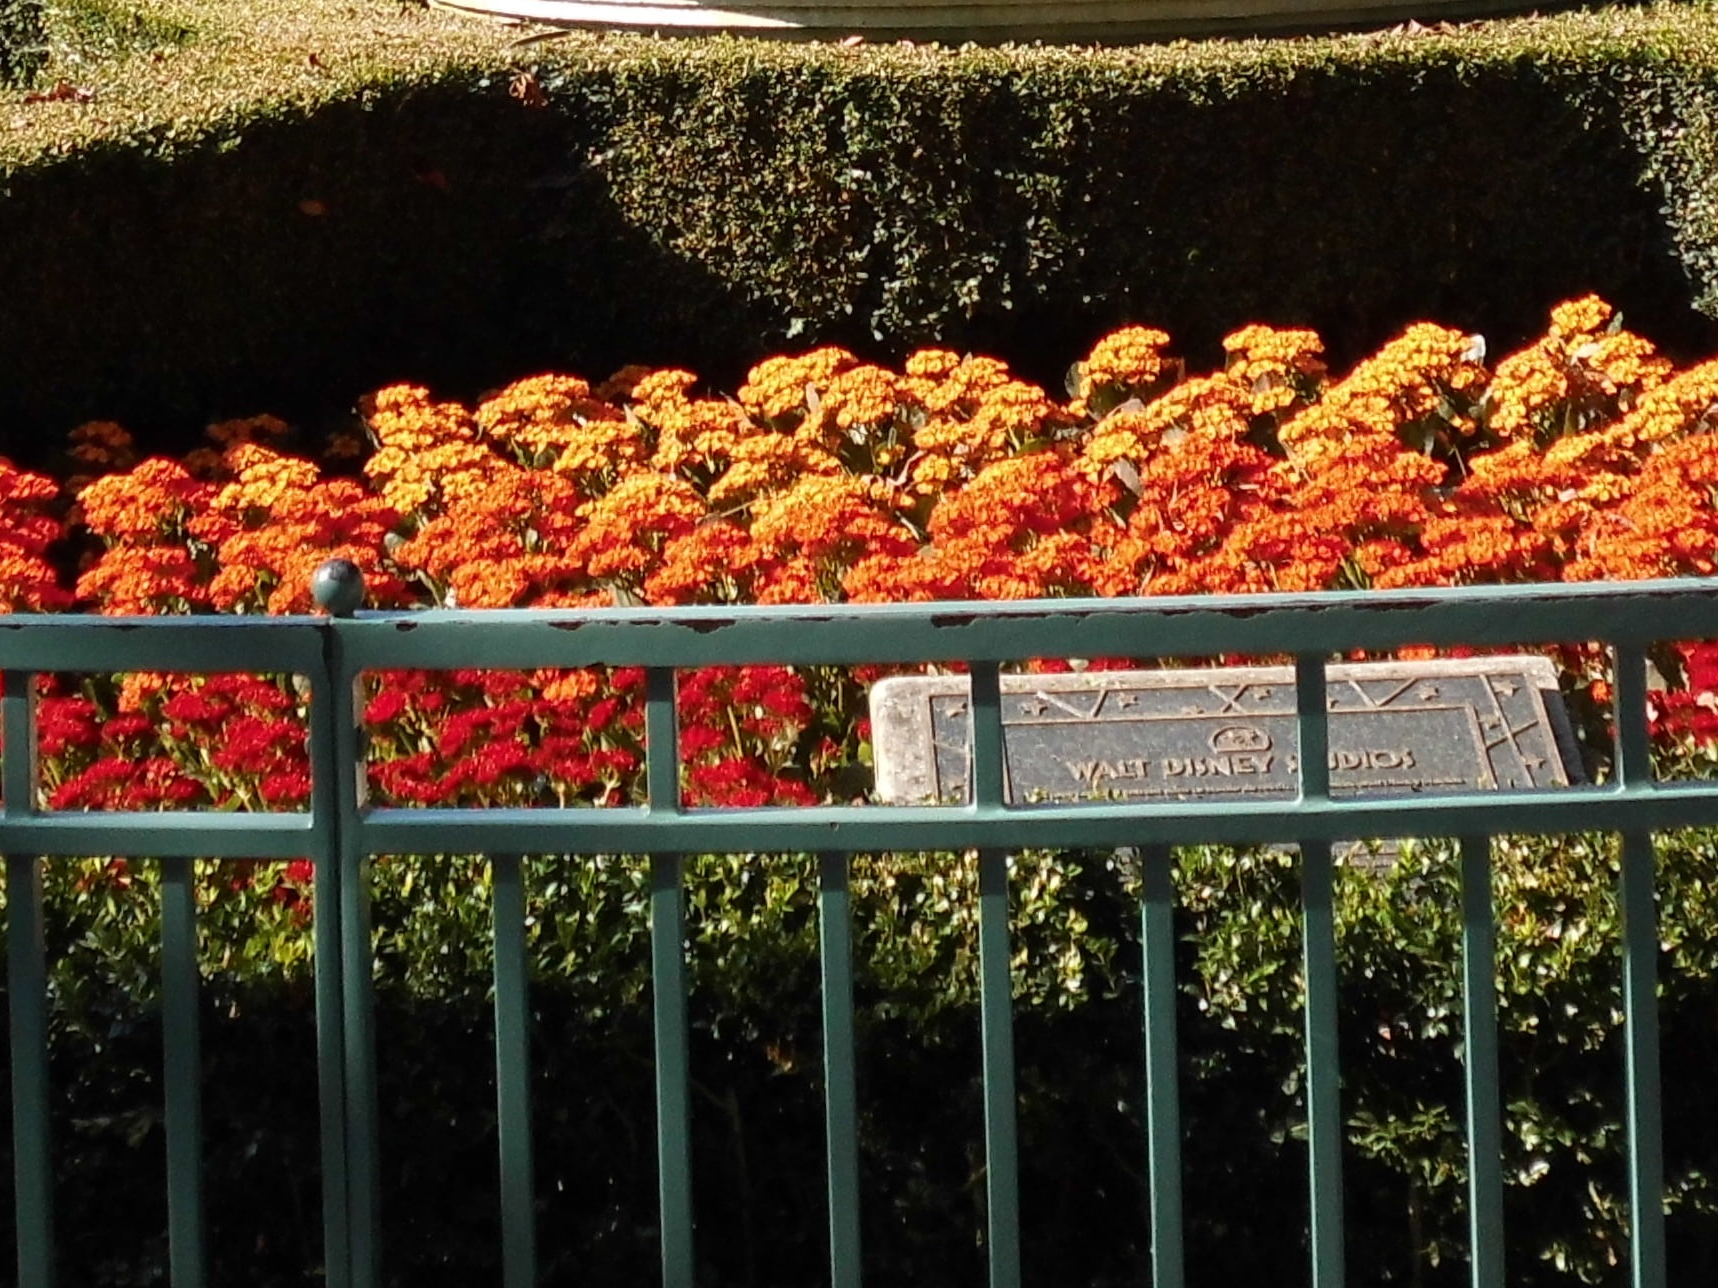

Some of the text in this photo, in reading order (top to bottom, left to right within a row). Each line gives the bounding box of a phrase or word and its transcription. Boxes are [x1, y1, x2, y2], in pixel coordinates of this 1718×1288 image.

[1067, 749, 1416, 781] WALT DISNEY SUDIOS
